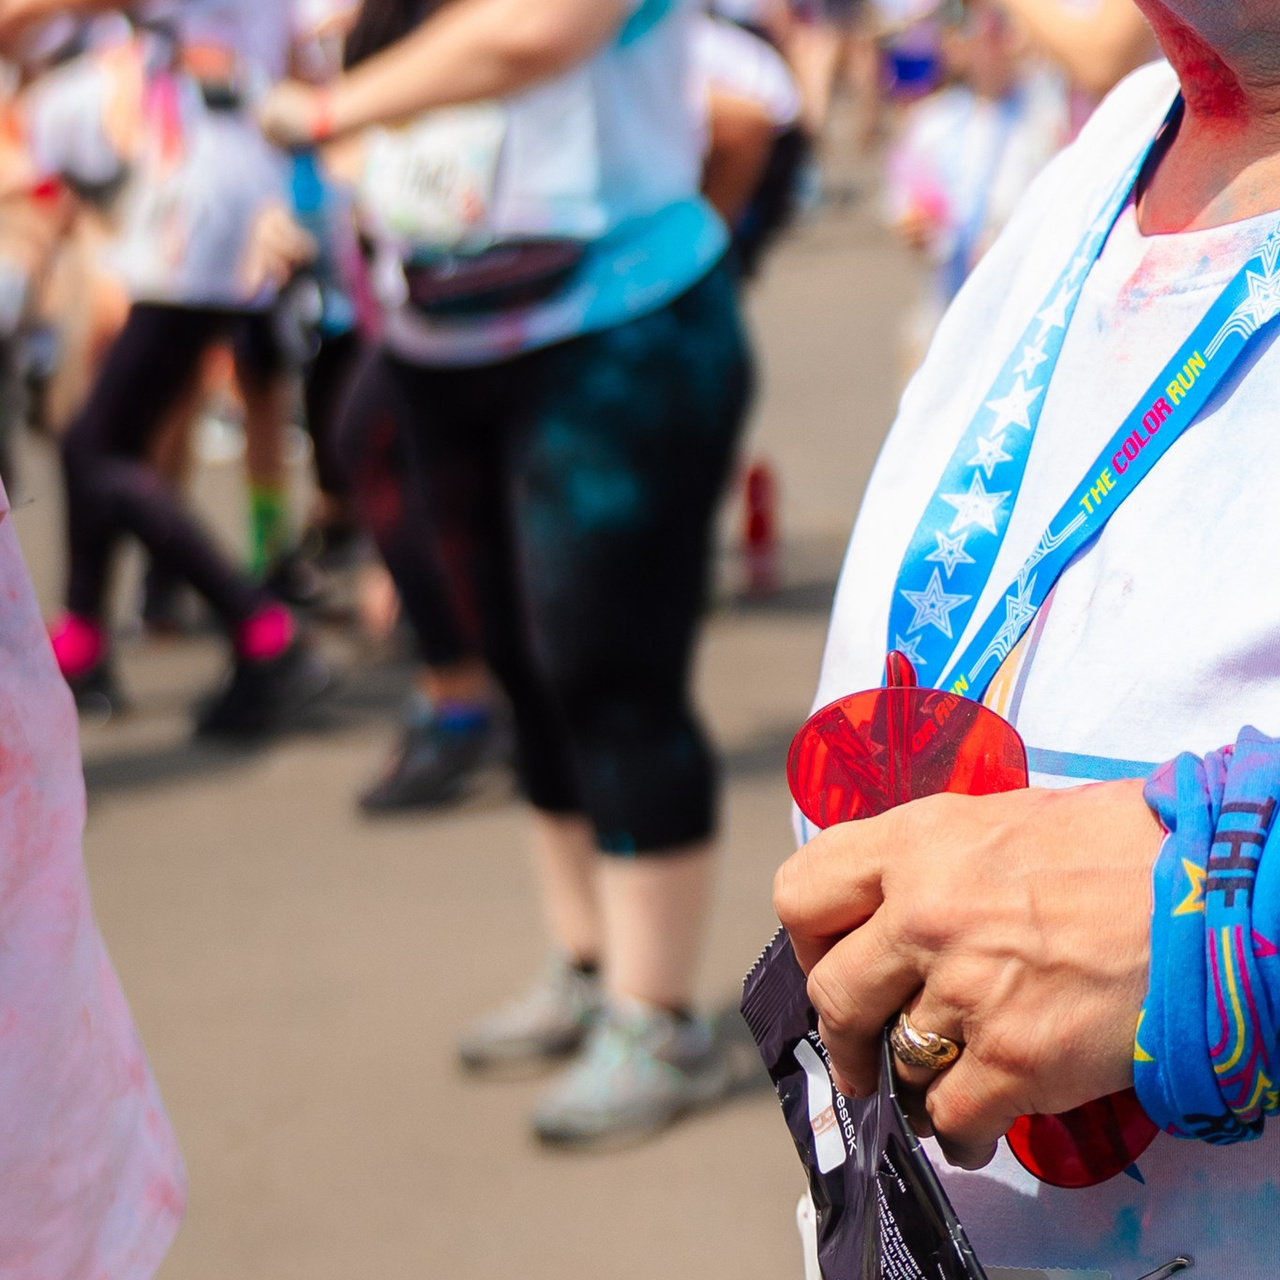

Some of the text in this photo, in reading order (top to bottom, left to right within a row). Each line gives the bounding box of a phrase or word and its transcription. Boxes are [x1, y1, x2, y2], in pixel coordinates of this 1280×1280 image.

[1079, 350, 1207, 514] THE COLOR RUN
[807, 1027, 857, 1156] #Haiest5K
[887, 1210, 895, 1224] Do
[892, 1237, 907, 1262] plenty
[901, 1243, 922, 1275] external
[904, 1263, 917, 1280] with
